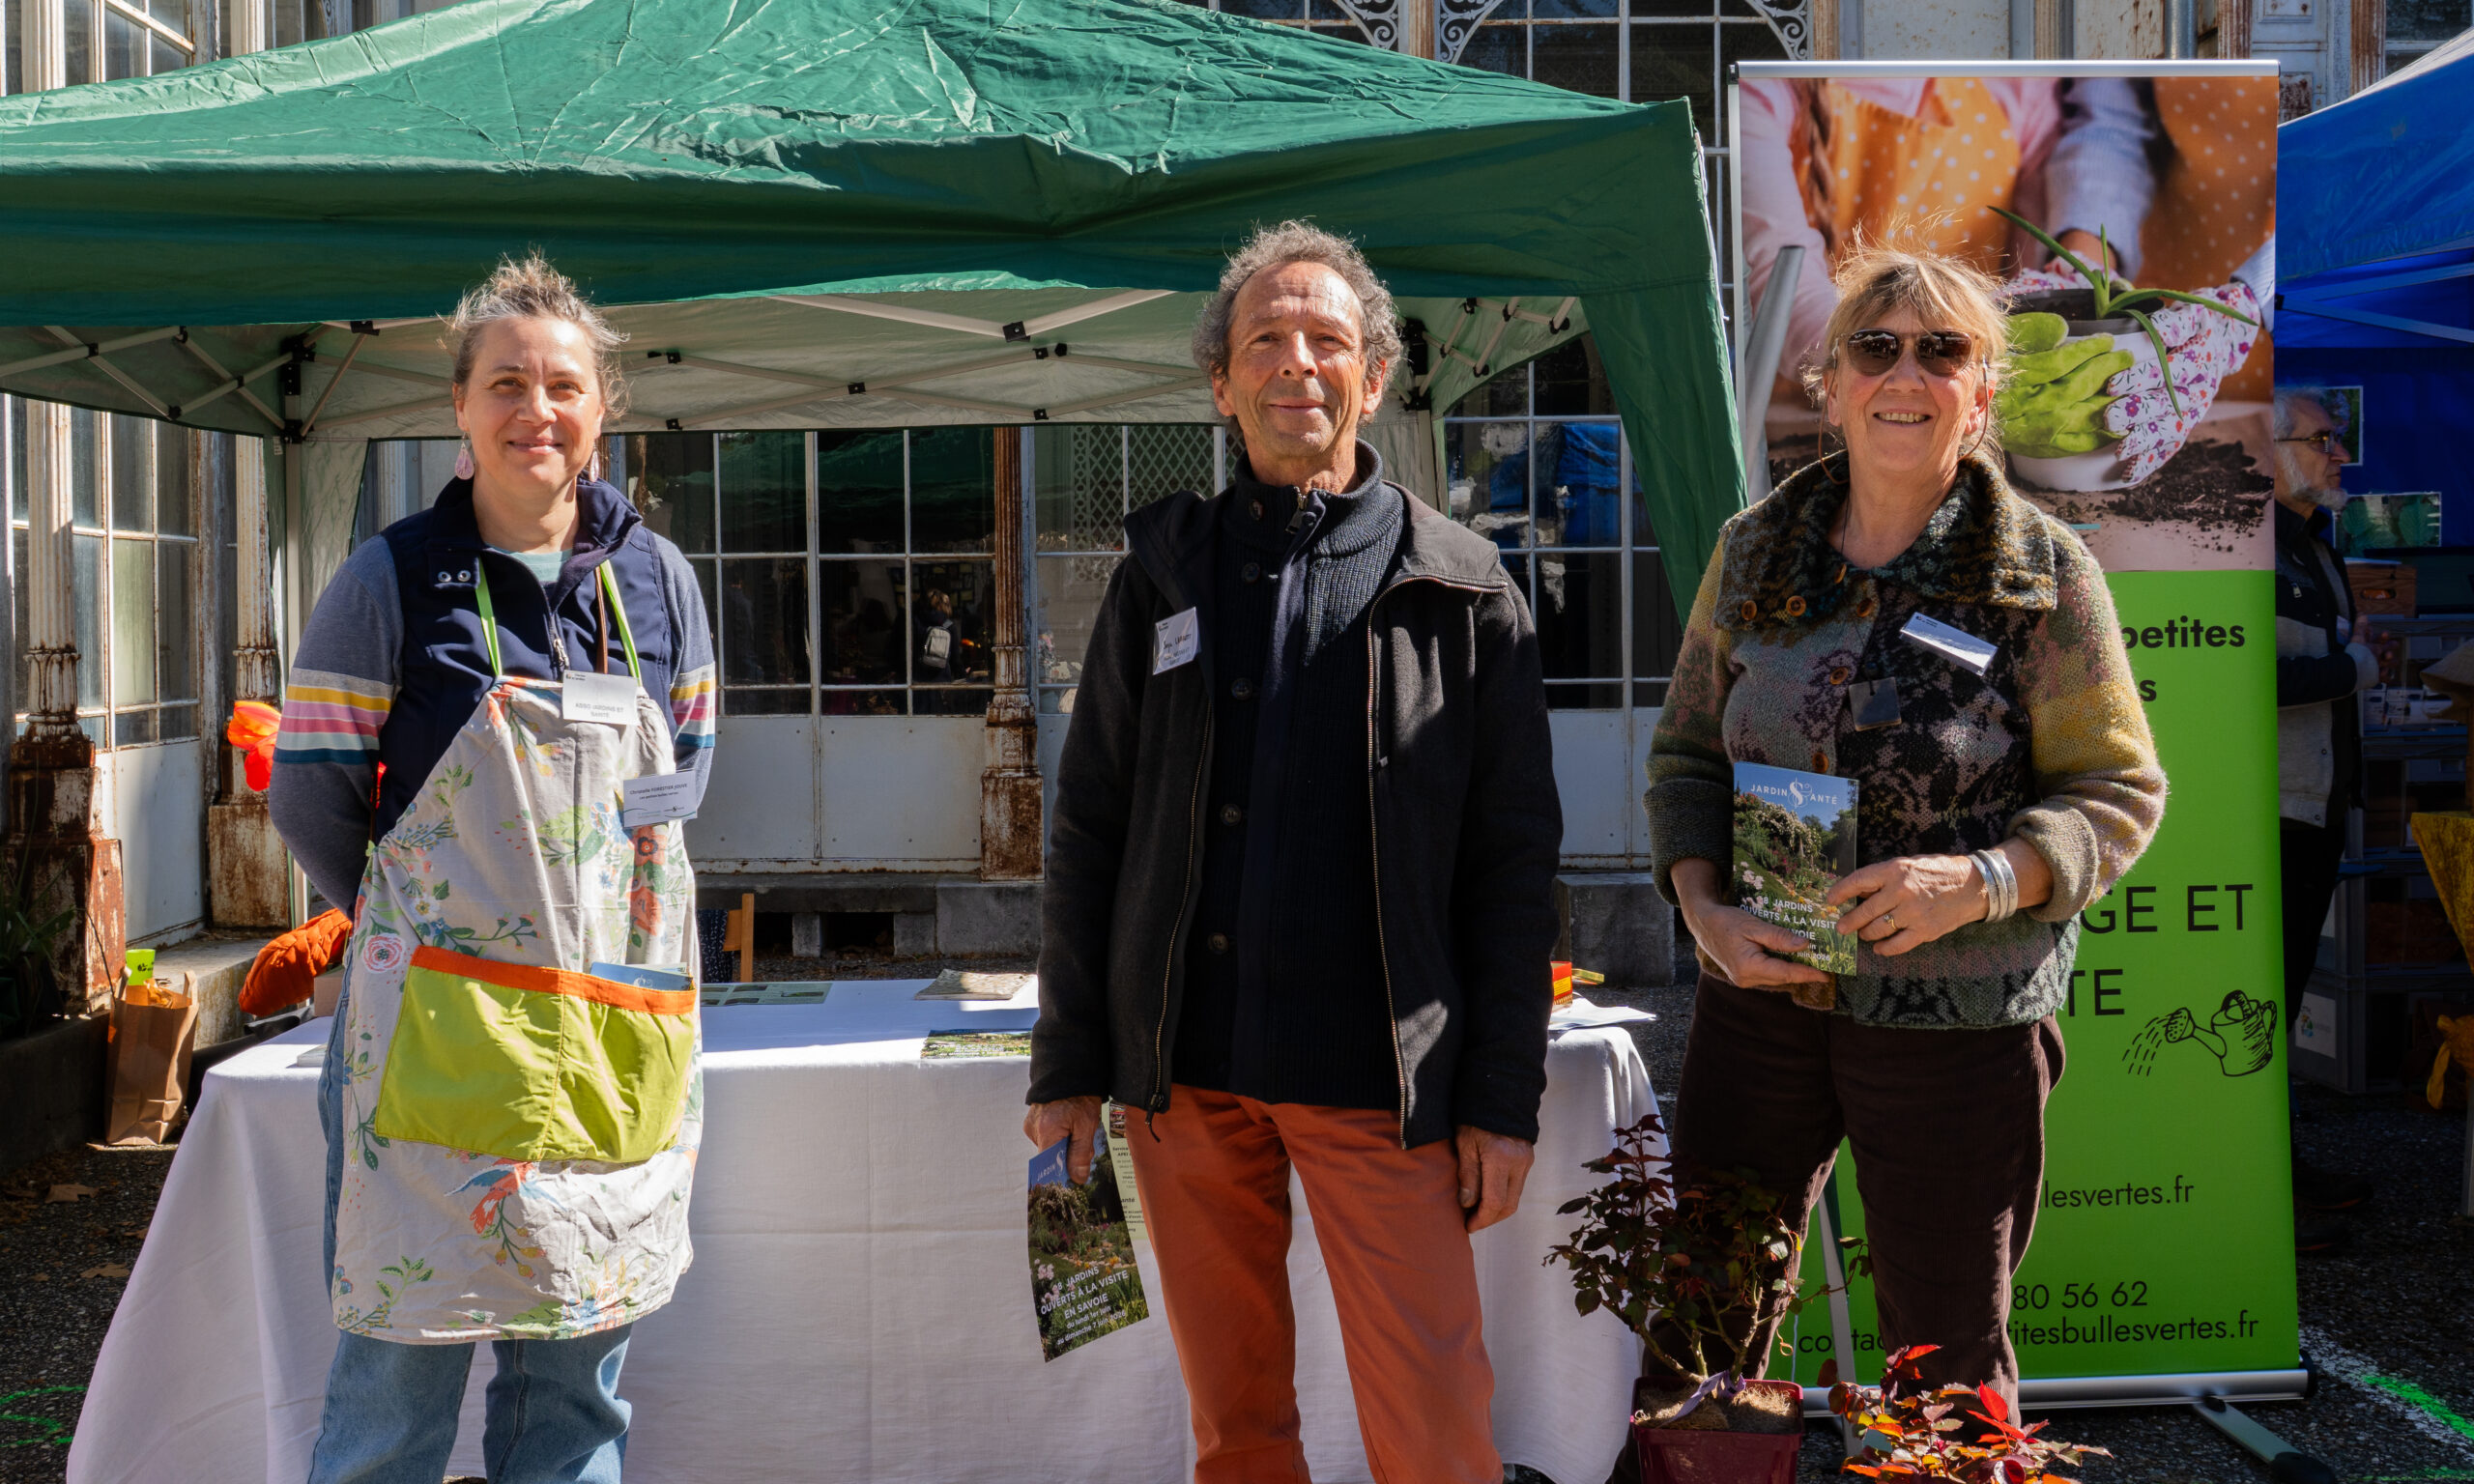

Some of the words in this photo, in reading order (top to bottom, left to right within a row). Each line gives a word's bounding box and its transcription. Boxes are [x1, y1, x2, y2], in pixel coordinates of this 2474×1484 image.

[1751, 784, 1788, 797] JARDIN
[1772, 899, 1814, 913] JARDINS
[2080, 886, 2157, 934] GE
[2187, 884, 2253, 931] ET
[1794, 916, 1807, 926] LA
[1809, 918, 1837, 929] VISIT
[2067, 969, 2125, 1016] TE
[2039, 1175, 2194, 1208] lesvertes.fr
[1066, 1266, 1100, 1287] JARDINS
[1041, 1291, 1076, 1314] OUVERTS
[1085, 1282, 1098, 1294] LA
[1099, 1270, 1129, 1288] VISITE
[1064, 1307, 1076, 1319] EN
[1078, 1293, 1108, 1313] SAVOIE
[2013, 1284, 2049, 1310] 80
[2061, 1282, 2098, 1309] 56
[2112, 1280, 2147, 1307] 62
